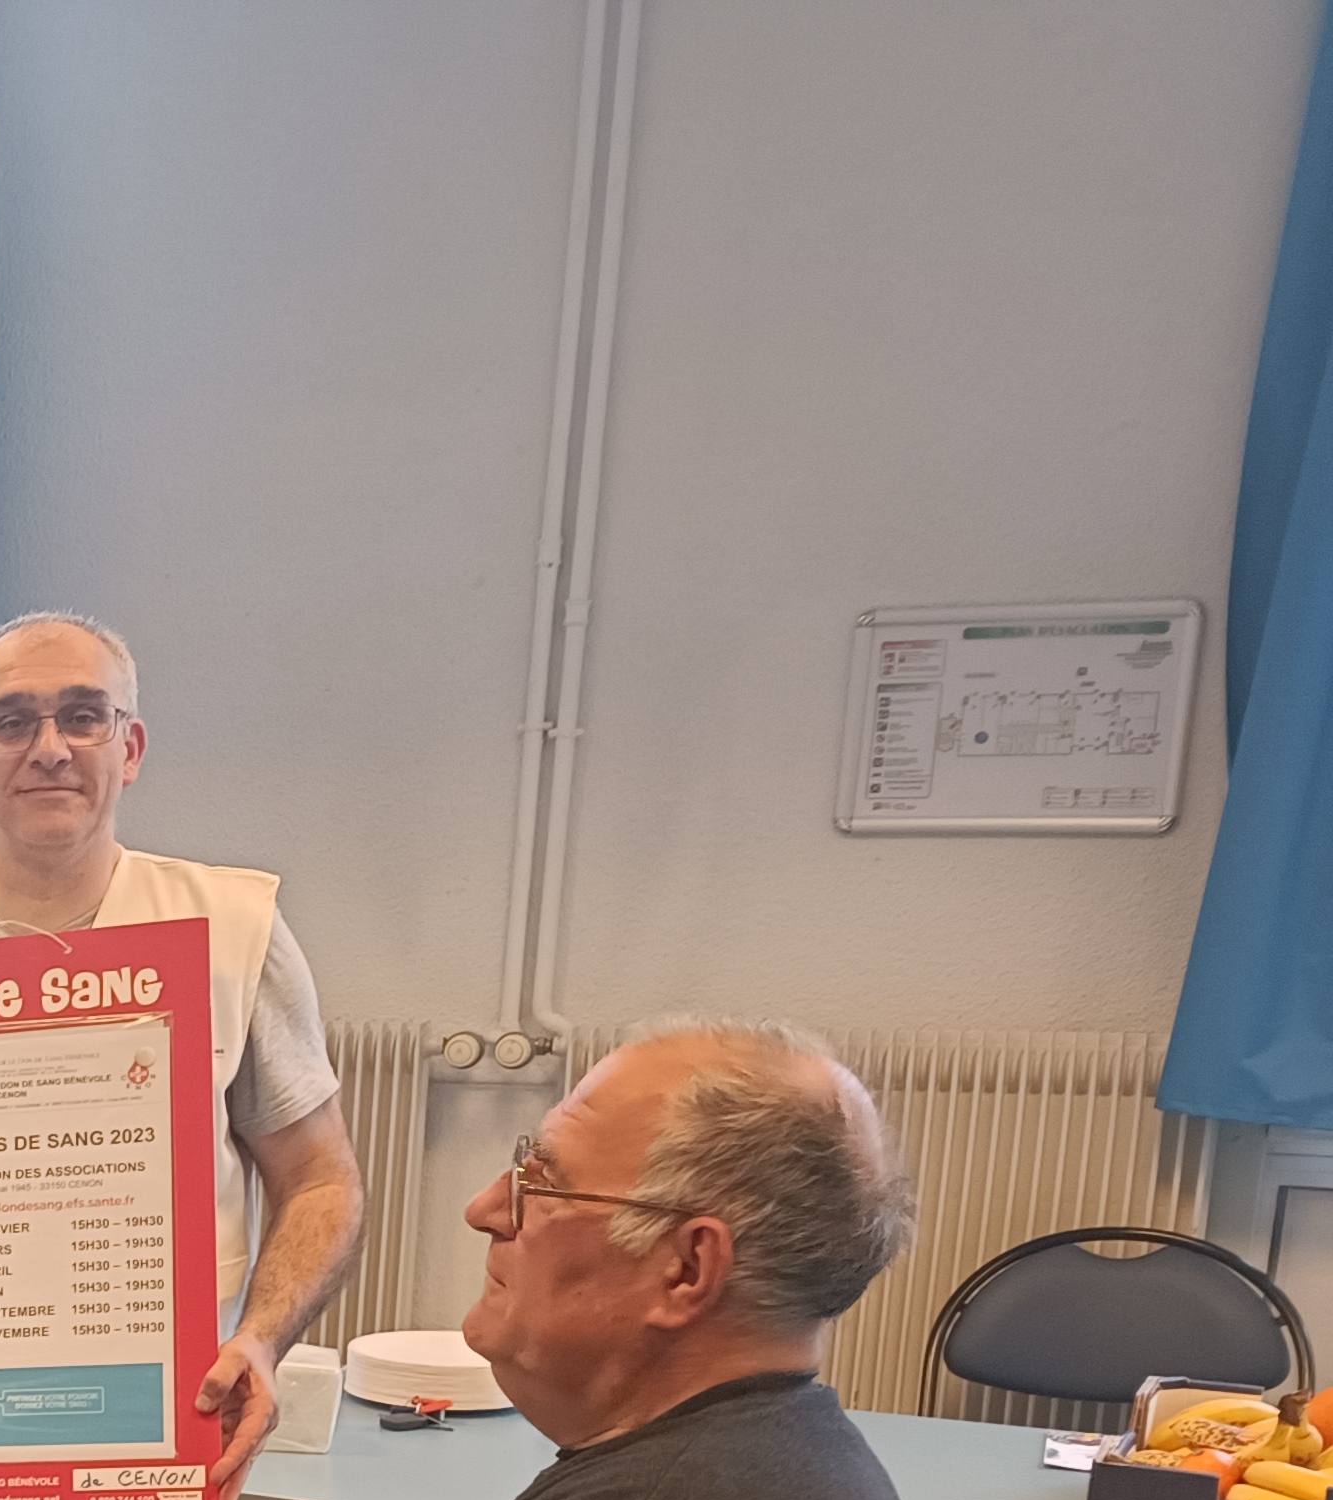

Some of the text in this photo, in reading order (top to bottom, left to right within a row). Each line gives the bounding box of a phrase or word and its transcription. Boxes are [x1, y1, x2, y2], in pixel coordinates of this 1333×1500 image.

[0, 1080, 19, 1089] DON
[21, 1079, 34, 1088] DE
[36, 1077, 62, 1086] SANG
[14, 1135, 41, 1151] DE
[47, 1130, 104, 1148] SANG
[110, 1127, 155, 1145] 2023
[15, 1167, 42, 1180] DES
[45, 1161, 146, 1179] ASSOCIATIONS
[68, 1179, 104, 1189] CENON
[71, 1218, 109, 1230] 15H30
[125, 1215, 163, 1227] 19H30
[71, 1239, 109, 1251] 15H30
[125, 1237, 163, 1248] 19H30
[72, 1260, 110, 1272] 15H30
[126, 1258, 164, 1270] 19H30
[72, 1281, 110, 1293] 15H30
[126, 1279, 164, 1291] 19H30
[72, 1303, 110, 1314] 15H30
[126, 1300, 164, 1312] 19H30
[72, 1324, 110, 1336] 15H30
[126, 1322, 164, 1333] 19H30
[81, 1468, 197, 1488] de CENON
